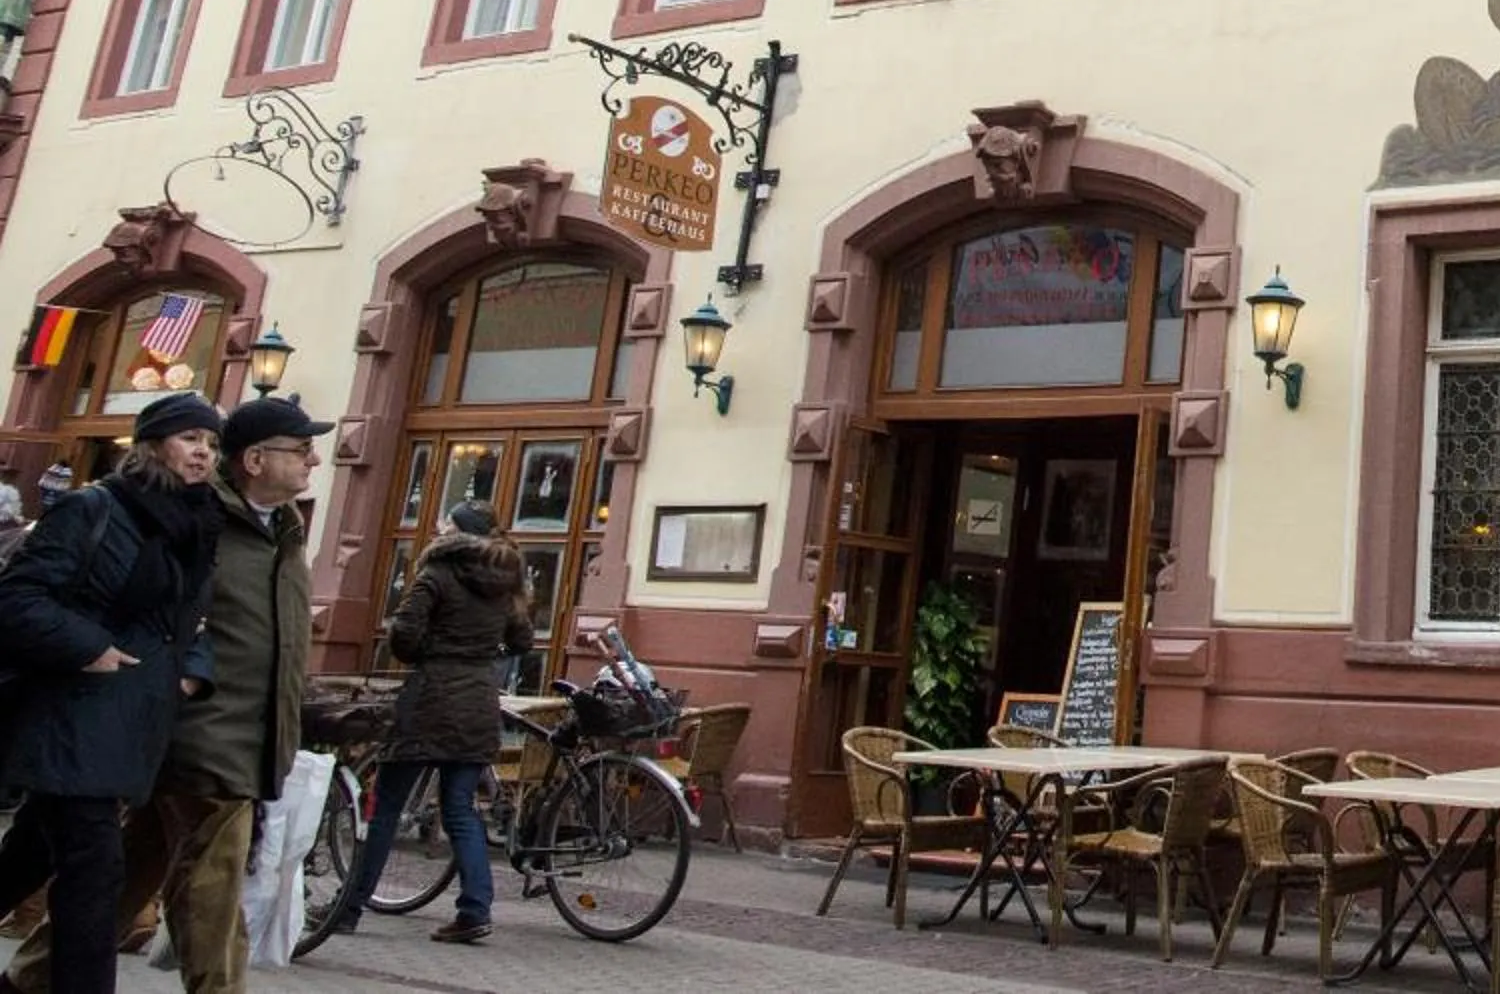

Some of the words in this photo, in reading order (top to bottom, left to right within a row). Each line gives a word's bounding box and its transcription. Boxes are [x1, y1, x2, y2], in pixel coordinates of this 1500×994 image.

[612, 152, 713, 205] PERKEO
[611, 202, 705, 241] KAFFEEHAUS
[612, 186, 709, 225] RESTAURANT
